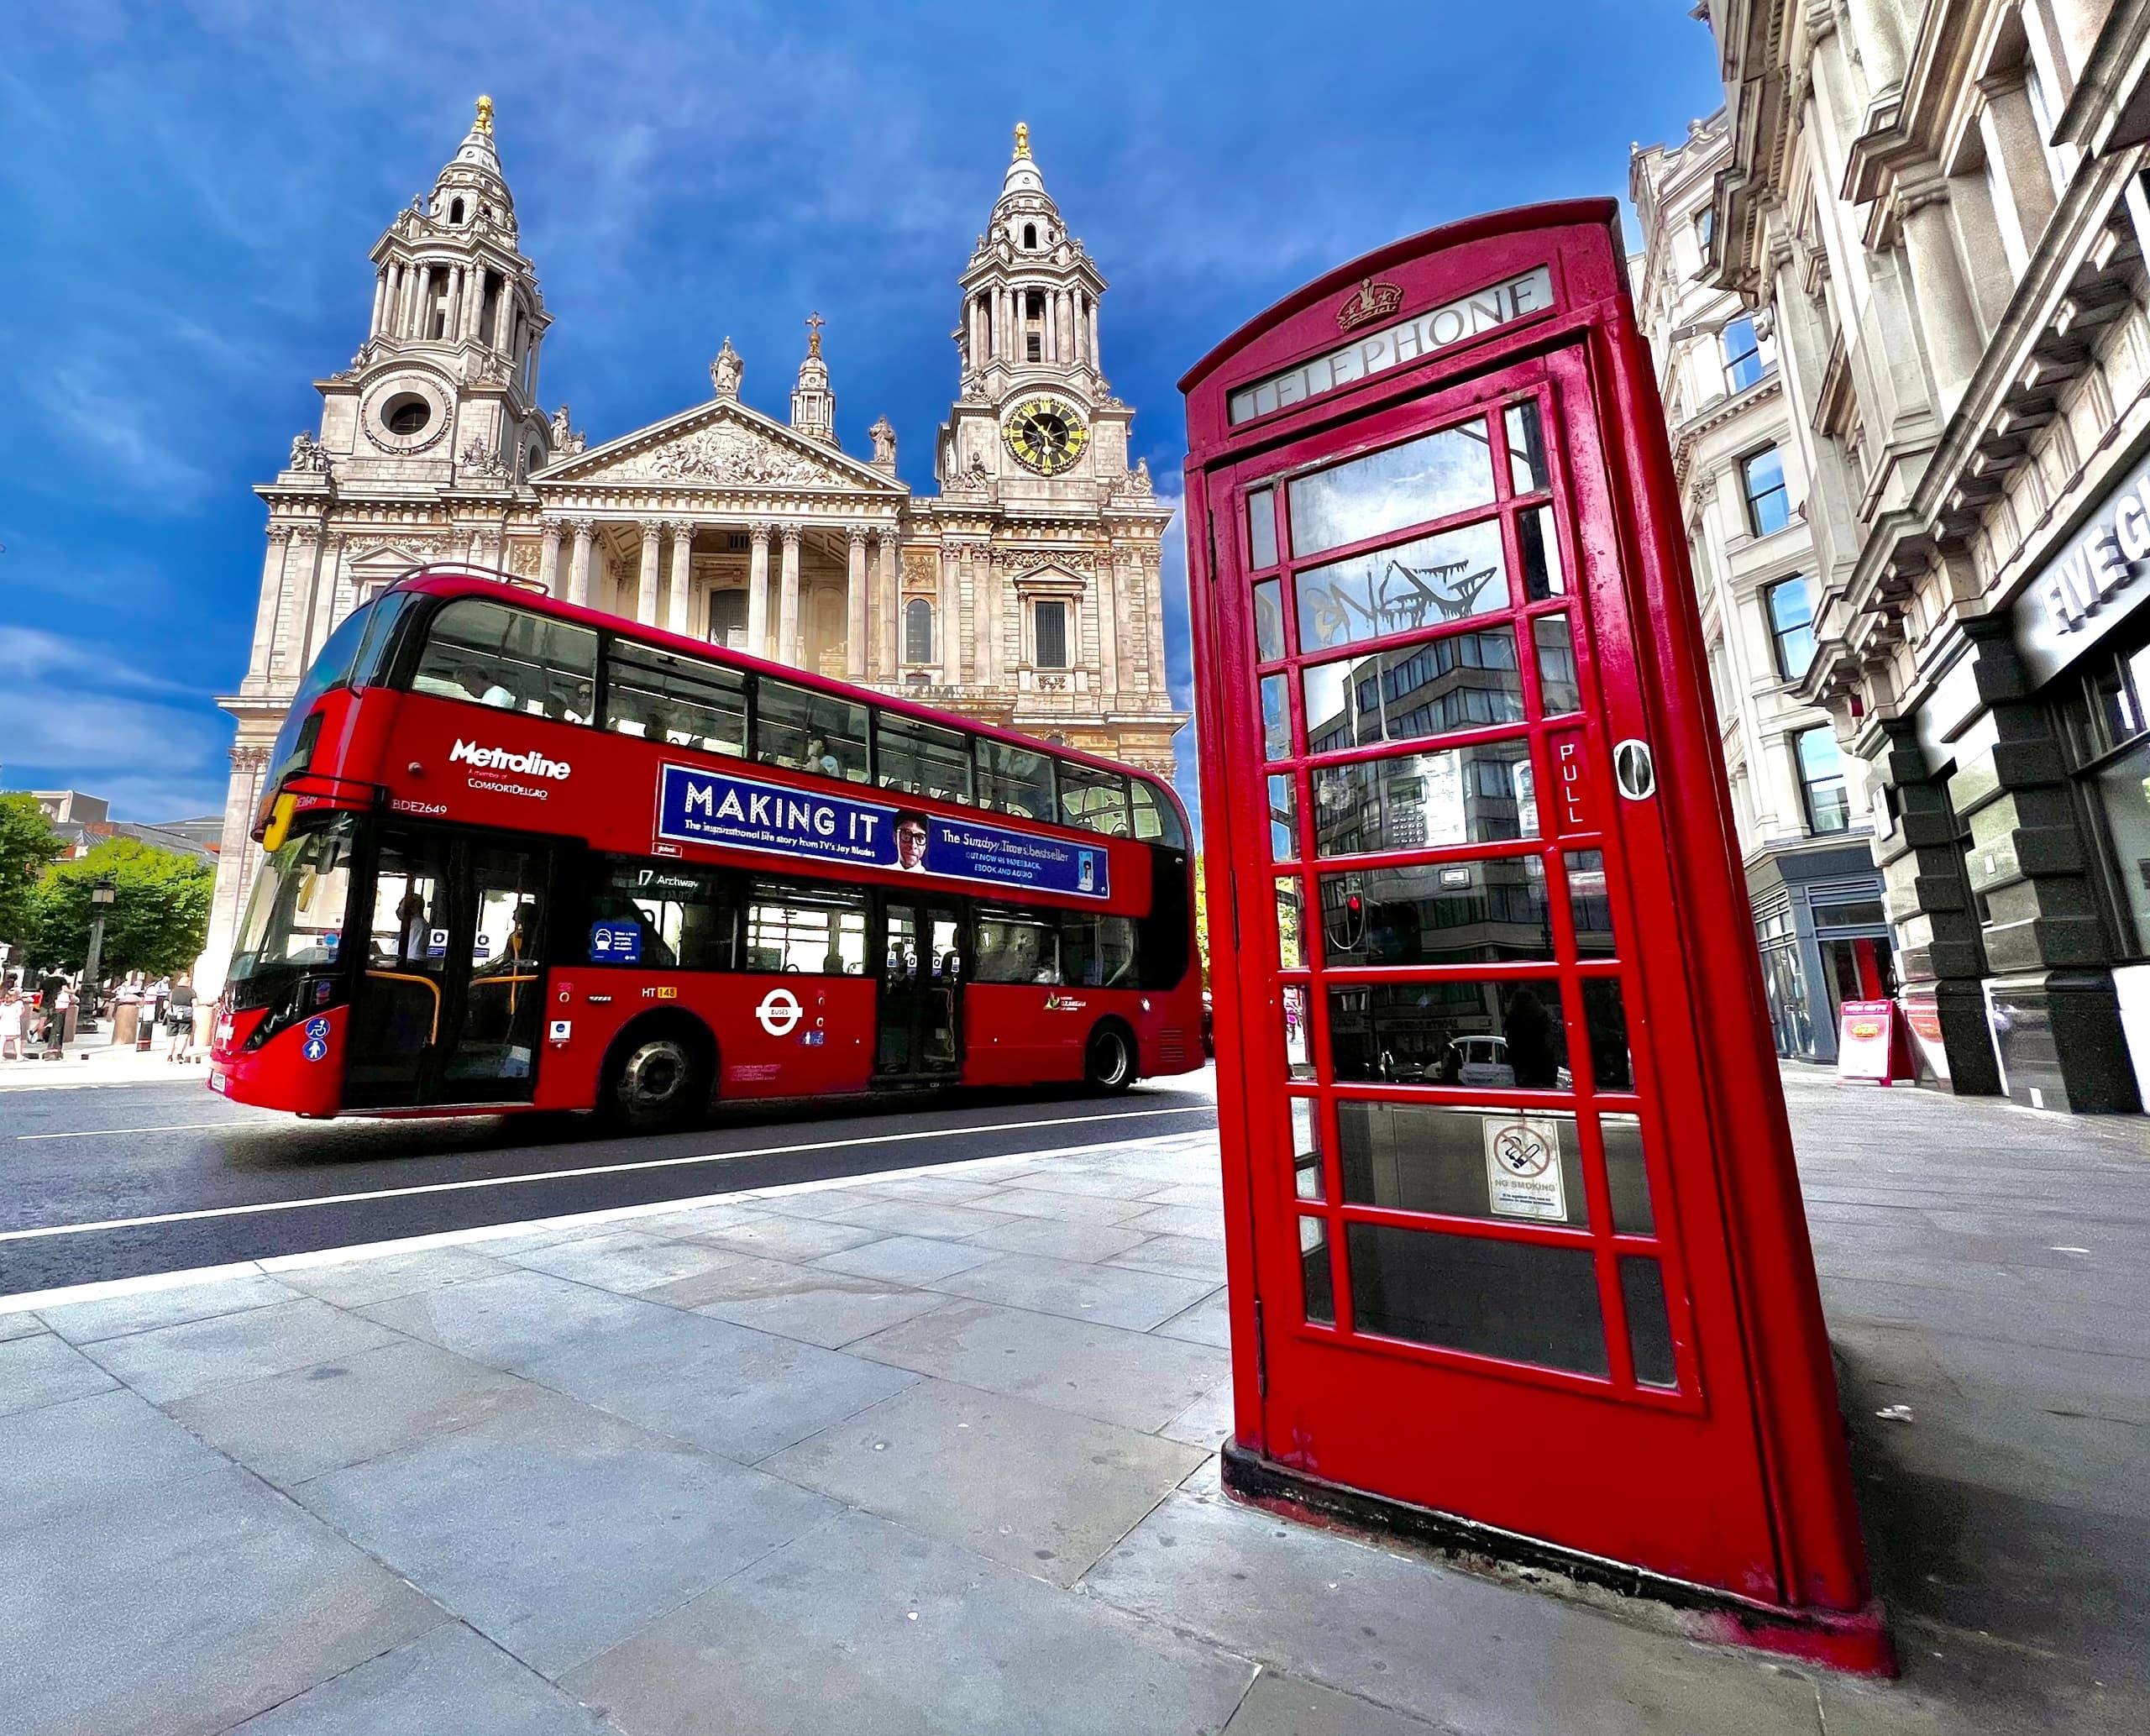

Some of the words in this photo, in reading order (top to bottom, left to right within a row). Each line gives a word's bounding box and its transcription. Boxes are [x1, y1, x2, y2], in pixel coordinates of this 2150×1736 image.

[1242, 276, 1540, 419] TELEPHONE
[2039, 525, 2128, 632] FIVE
[449, 738, 571, 780] Metroline
[1560, 743, 1583, 822] PULL
[391, 799, 448, 815] BDE2649
[684, 781, 836, 836] MAKING
[849, 811, 879, 843] IT
[684, 819, 702, 831] The
[776, 836, 798, 847] story
[819, 841, 836, 852] TV's
[836, 843, 851, 855] Jay
[942, 830, 961, 844] The
[962, 832, 998, 853] Sunday
[1001, 840, 1027, 856] Times
[1028, 843, 1069, 863] bestseller
[979, 853, 997, 863] NOW
[997, 867, 1011, 876] AND
[656, 874, 700, 890] Archway
[642, 988, 656, 998] HT
[1495, 1178, 1508, 1188] NO
[1512, 1180, 1556, 1193] SMOKING
